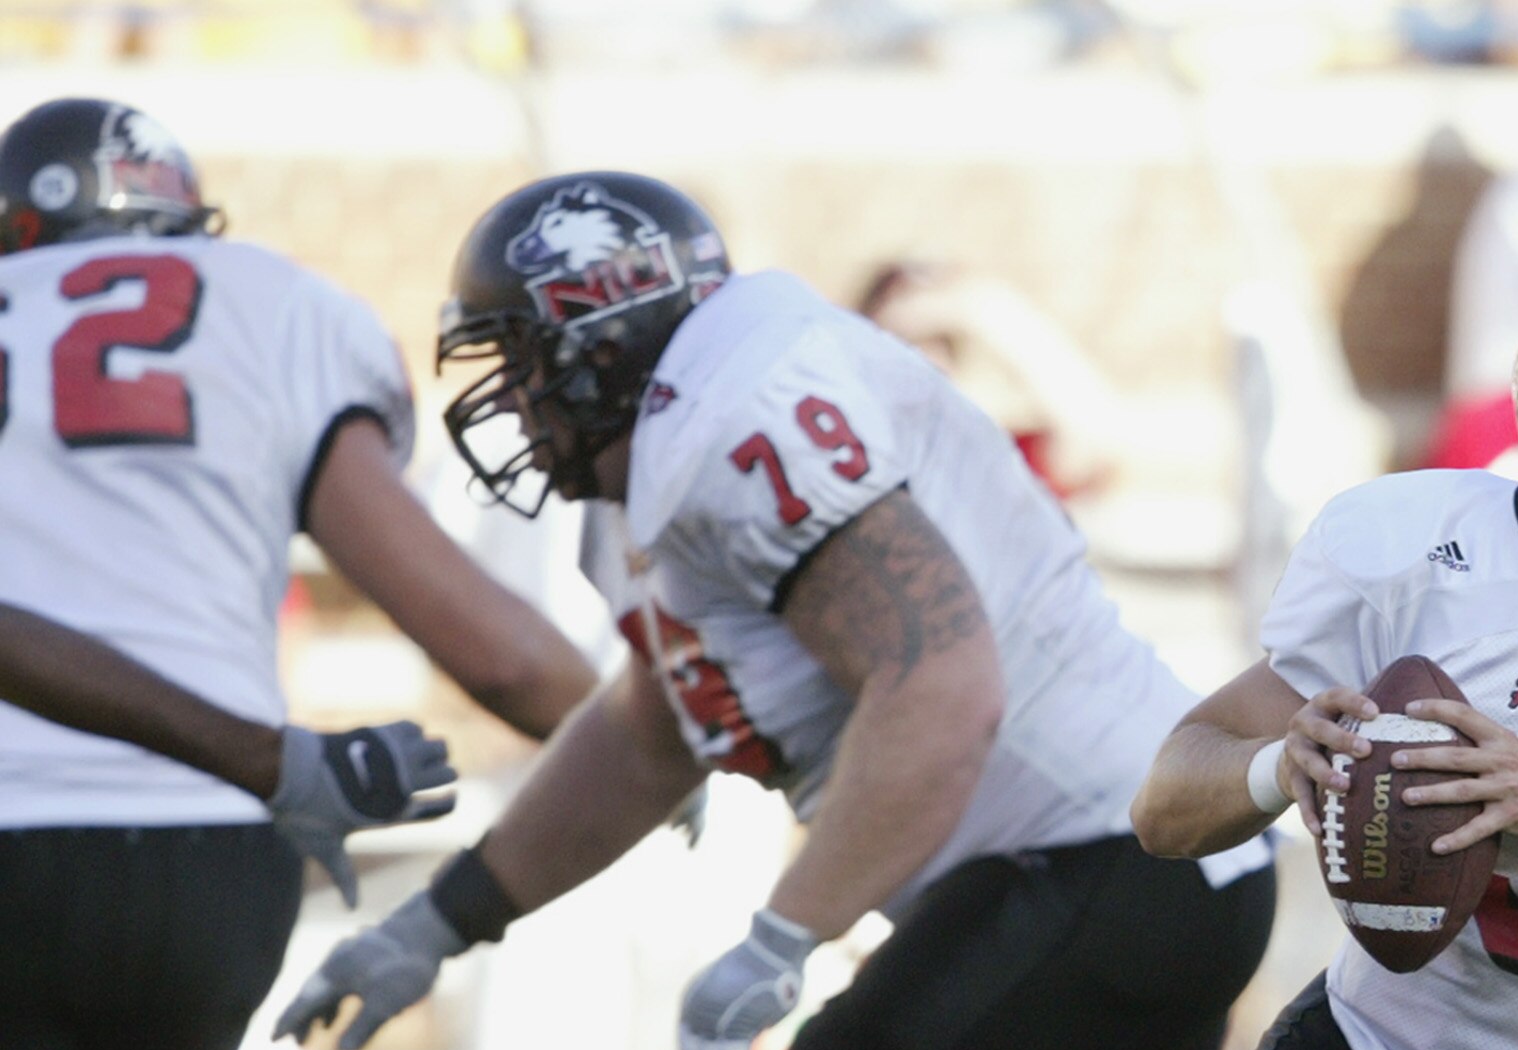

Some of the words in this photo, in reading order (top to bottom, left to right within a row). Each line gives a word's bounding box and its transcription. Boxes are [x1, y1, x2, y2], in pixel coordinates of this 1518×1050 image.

[543, 244, 671, 324] NIU
[0, 254, 203, 448] 2
[728, 394, 870, 526] 79
[1427, 552, 1470, 572] adidas
[1362, 772, 1393, 880] Wilson
